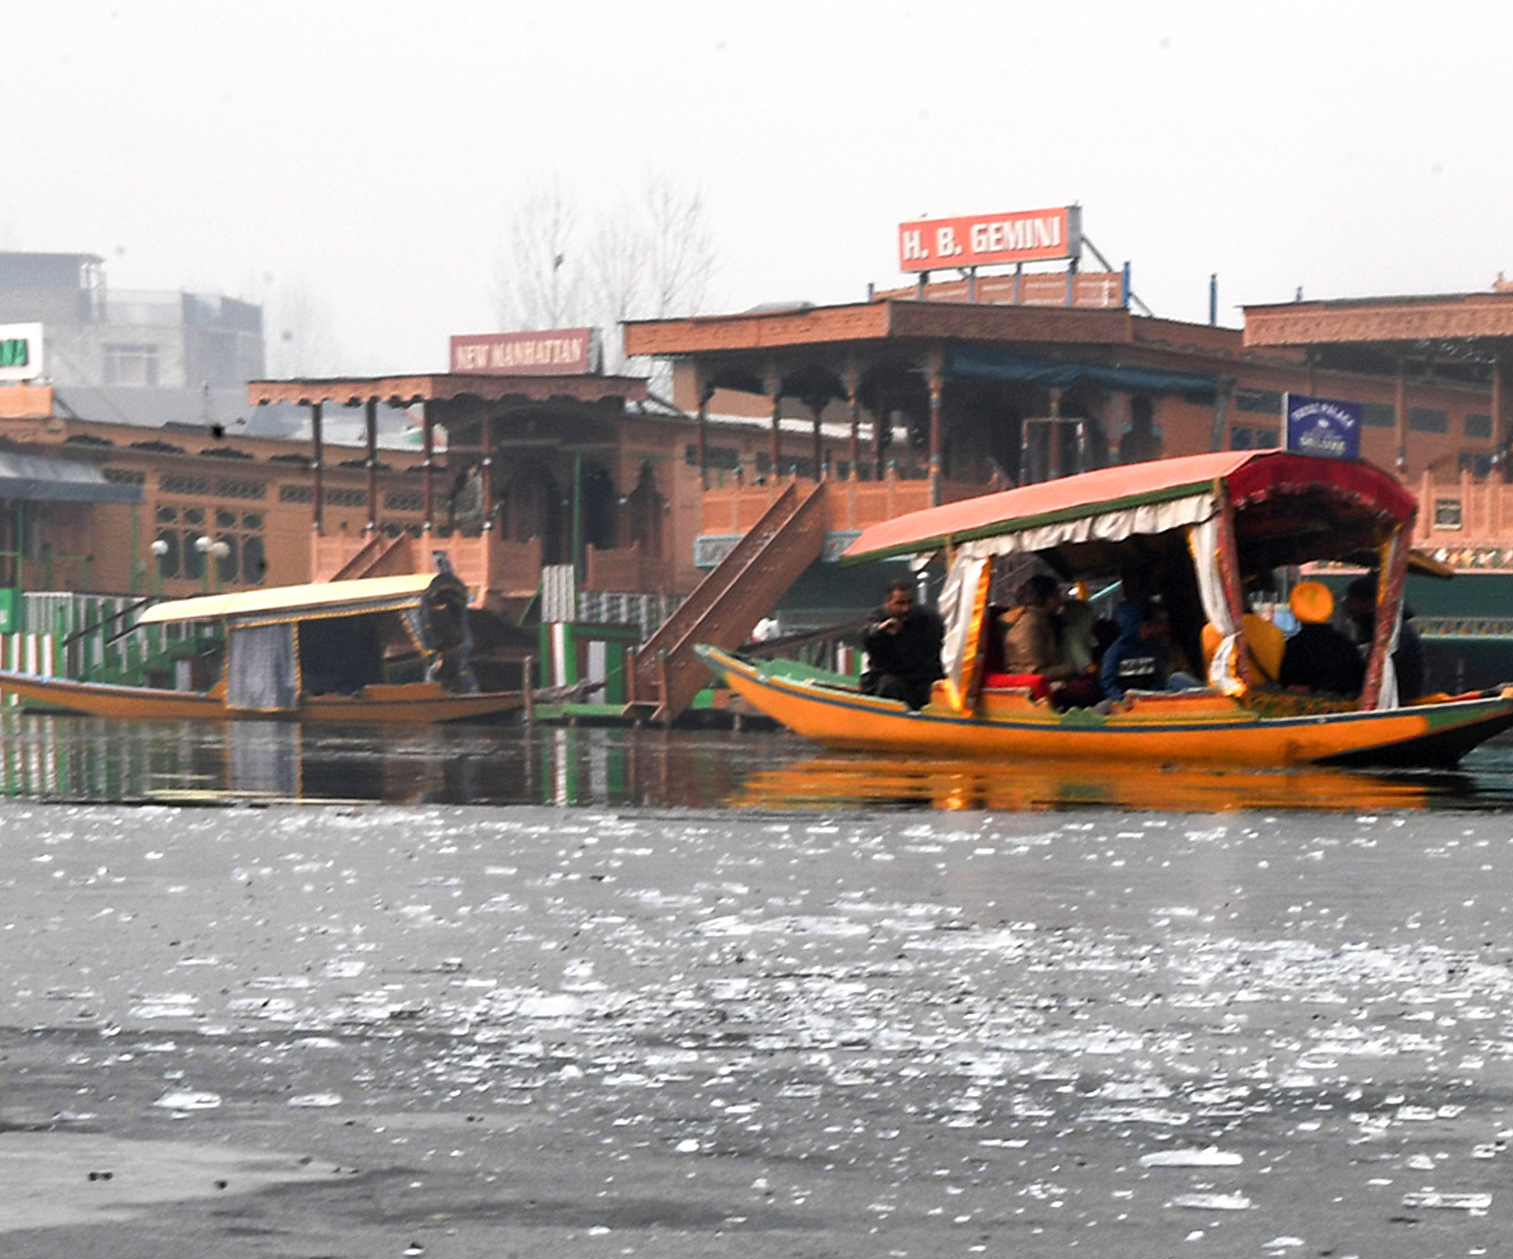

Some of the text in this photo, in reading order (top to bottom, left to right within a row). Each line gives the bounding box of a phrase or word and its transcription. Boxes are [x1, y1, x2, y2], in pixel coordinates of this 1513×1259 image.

[902, 216, 1061, 260] H. B. GEMINI
[454, 338, 583, 370] NEW MANHATTAN
